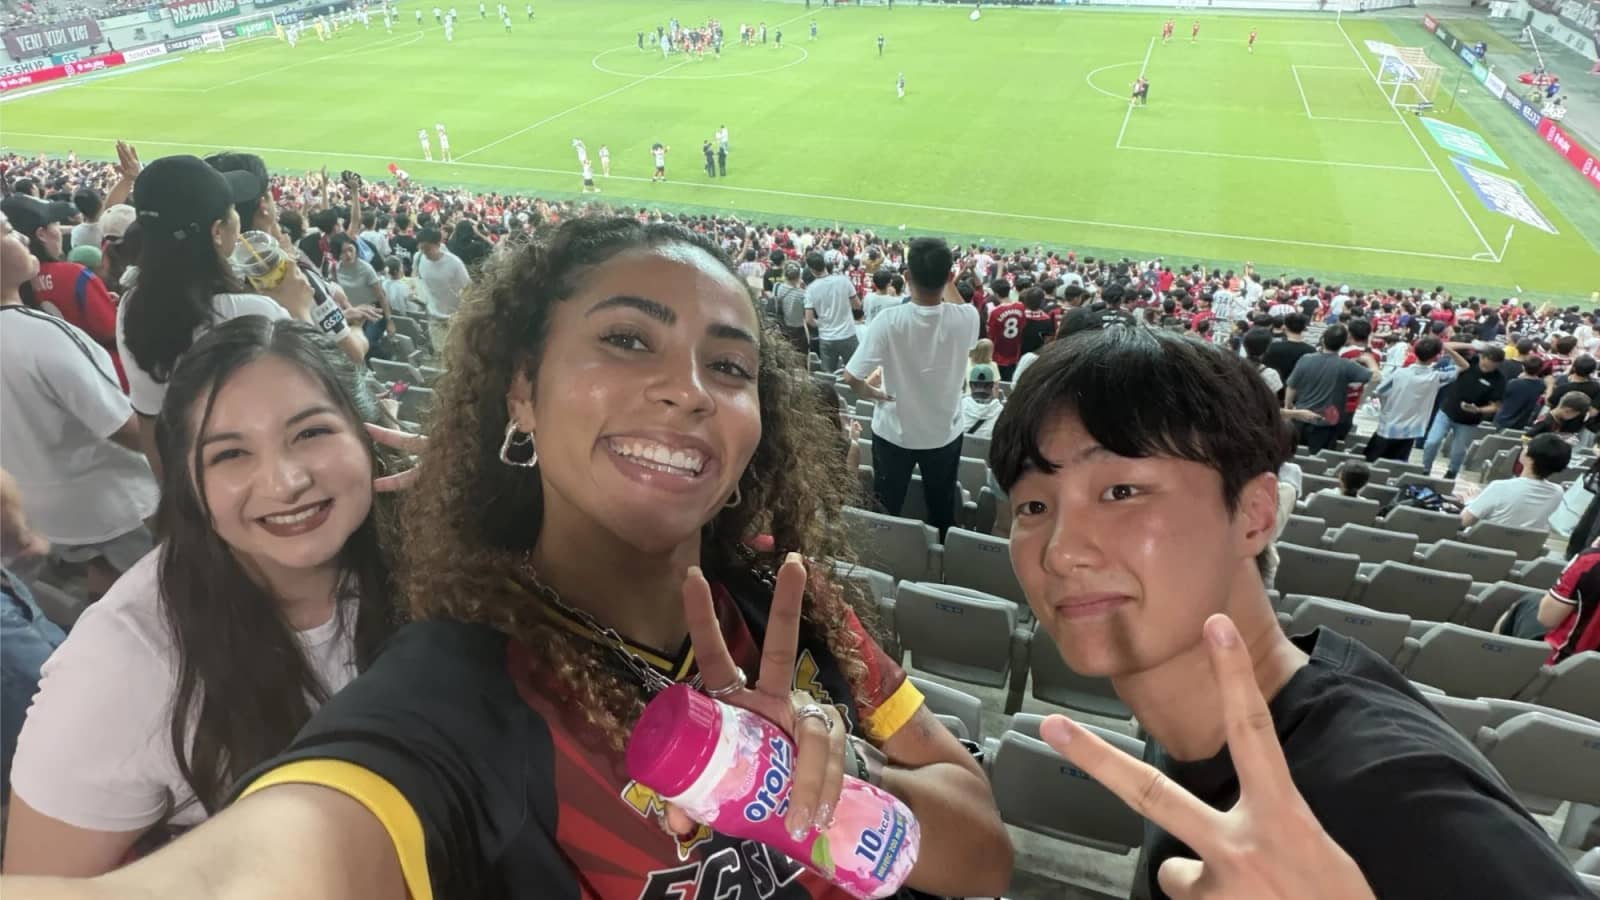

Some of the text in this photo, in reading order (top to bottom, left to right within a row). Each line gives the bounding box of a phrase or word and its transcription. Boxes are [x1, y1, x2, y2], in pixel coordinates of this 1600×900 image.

[1003, 317, 1019, 339] 8
[745, 738, 791, 821] 아이스
[856, 829, 882, 862] 10
